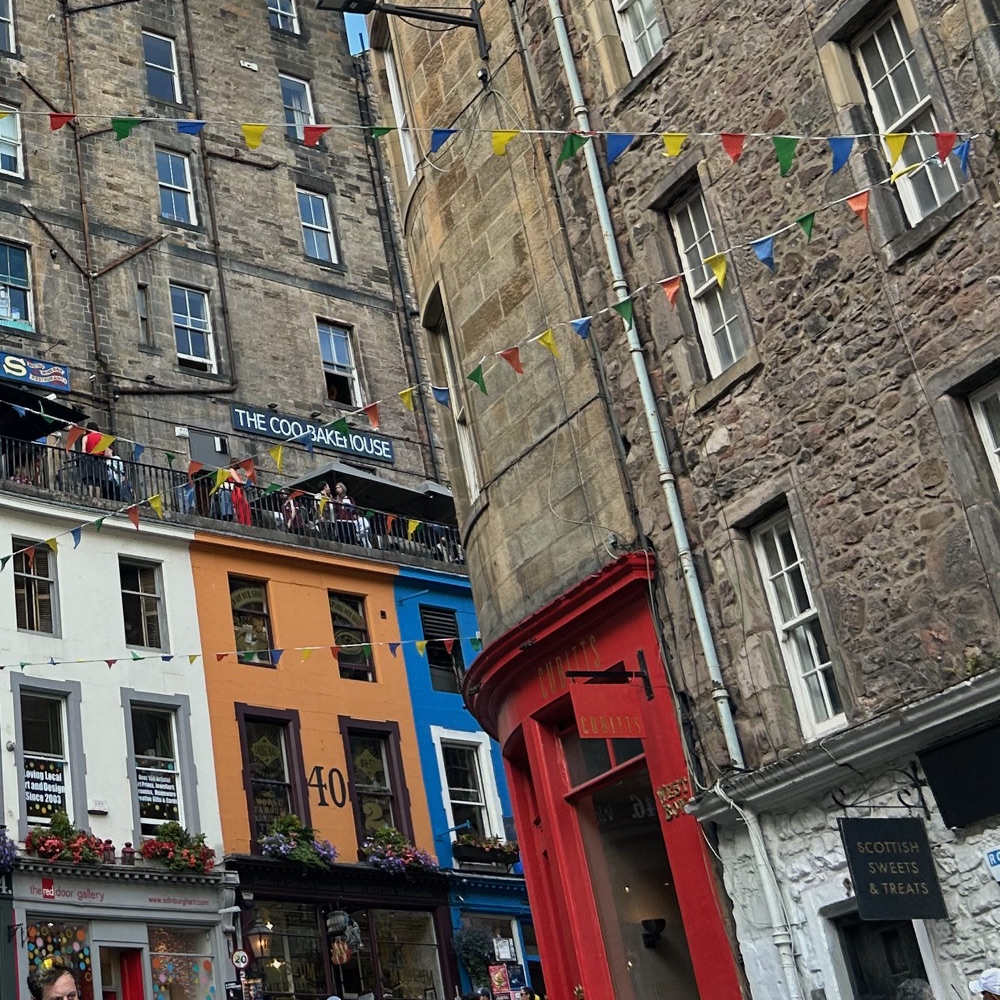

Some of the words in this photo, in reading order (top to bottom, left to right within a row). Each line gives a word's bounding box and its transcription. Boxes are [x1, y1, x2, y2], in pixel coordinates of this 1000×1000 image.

[235, 408, 267, 431] THE
[580, 716, 642, 734] CUBITTS
[44, 771, 62, 782] Local
[31, 781, 43, 791] and
[43, 783, 65, 795] Design
[307, 765, 347, 808] 40
[656, 777, 687, 805] WEST
[26, 792, 44, 802] Since
[45, 794, 61, 804] 2003
[857, 842, 919, 854] SCOTTISH
[868, 861, 919, 874] SWEETS
[30, 884, 41, 896] the
[43, 885, 54, 896] red
[56, 886, 73, 898] door
[77, 888, 105, 902] gallery
[869, 882, 879, 895] &
[881, 882, 929, 895] TREATS
[234, 954, 247, 964] 20
